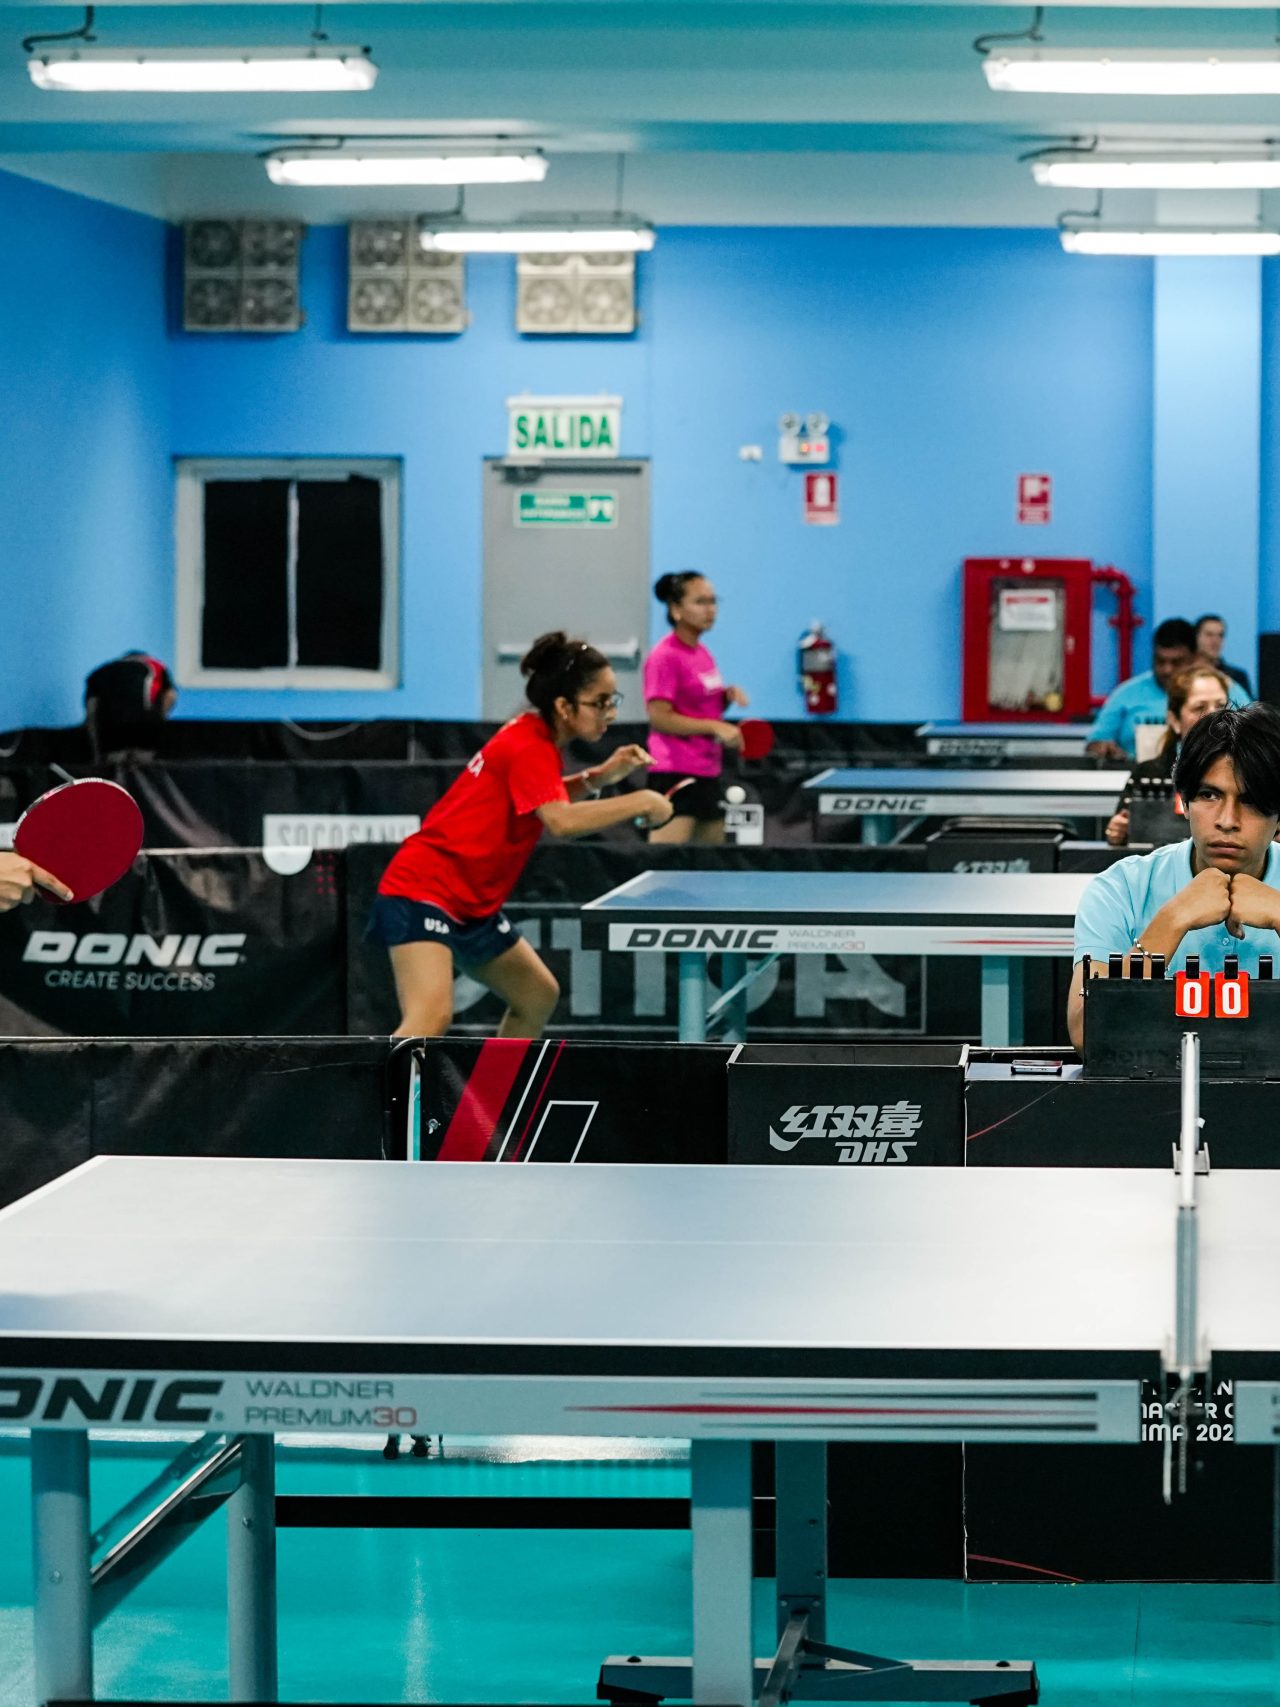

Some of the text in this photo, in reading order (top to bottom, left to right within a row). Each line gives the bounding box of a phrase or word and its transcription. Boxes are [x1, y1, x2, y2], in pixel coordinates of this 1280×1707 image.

[516, 415, 612, 449] SALIDA
[832, 797, 928, 812] DONIC
[424, 917, 450, 934] USA
[788, 929, 856, 938] WALDNER
[22, 931, 246, 966] DONIC
[627, 928, 779, 949] DONIC
[787, 940, 866, 951] PREMIUM30
[44, 970, 216, 991] CREATE SUCCESS
[1183, 981, 1241, 1015] 0 0
[769, 1101, 924, 1151] 红双喜
[834, 1142, 918, 1163] DHS
[246, 1380, 395, 1399] WALDNER
[245, 1406, 418, 1427] PREMIUM30
